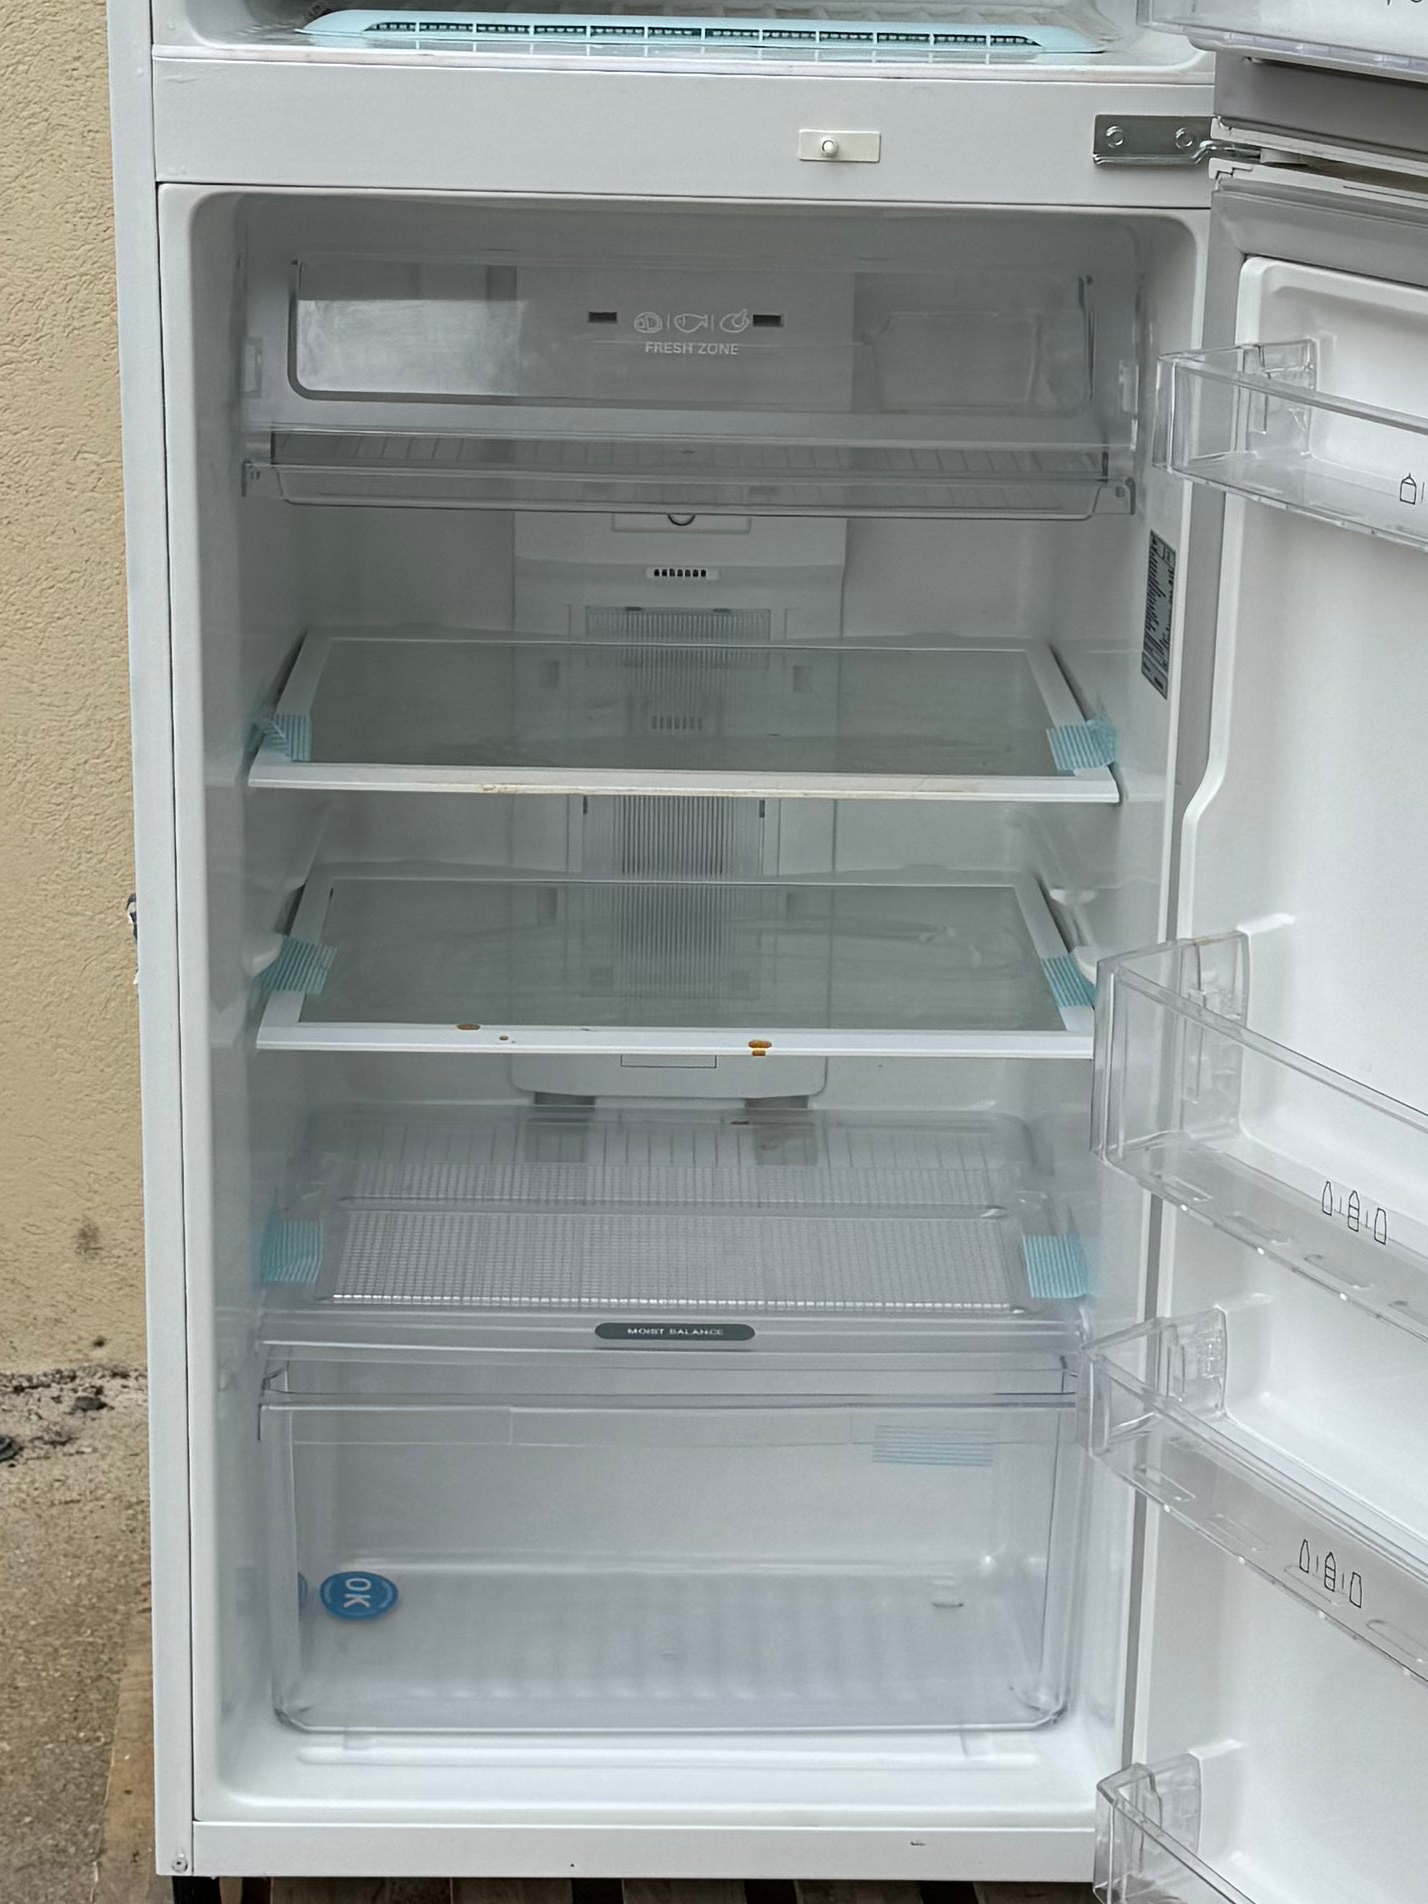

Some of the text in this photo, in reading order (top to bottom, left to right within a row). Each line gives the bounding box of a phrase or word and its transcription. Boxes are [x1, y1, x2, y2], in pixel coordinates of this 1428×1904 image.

[645, 342, 739, 355] FRESH ZONE
[627, 1327, 724, 1336] MOIST BALANCE
[344, 1578, 371, 1608] OK
